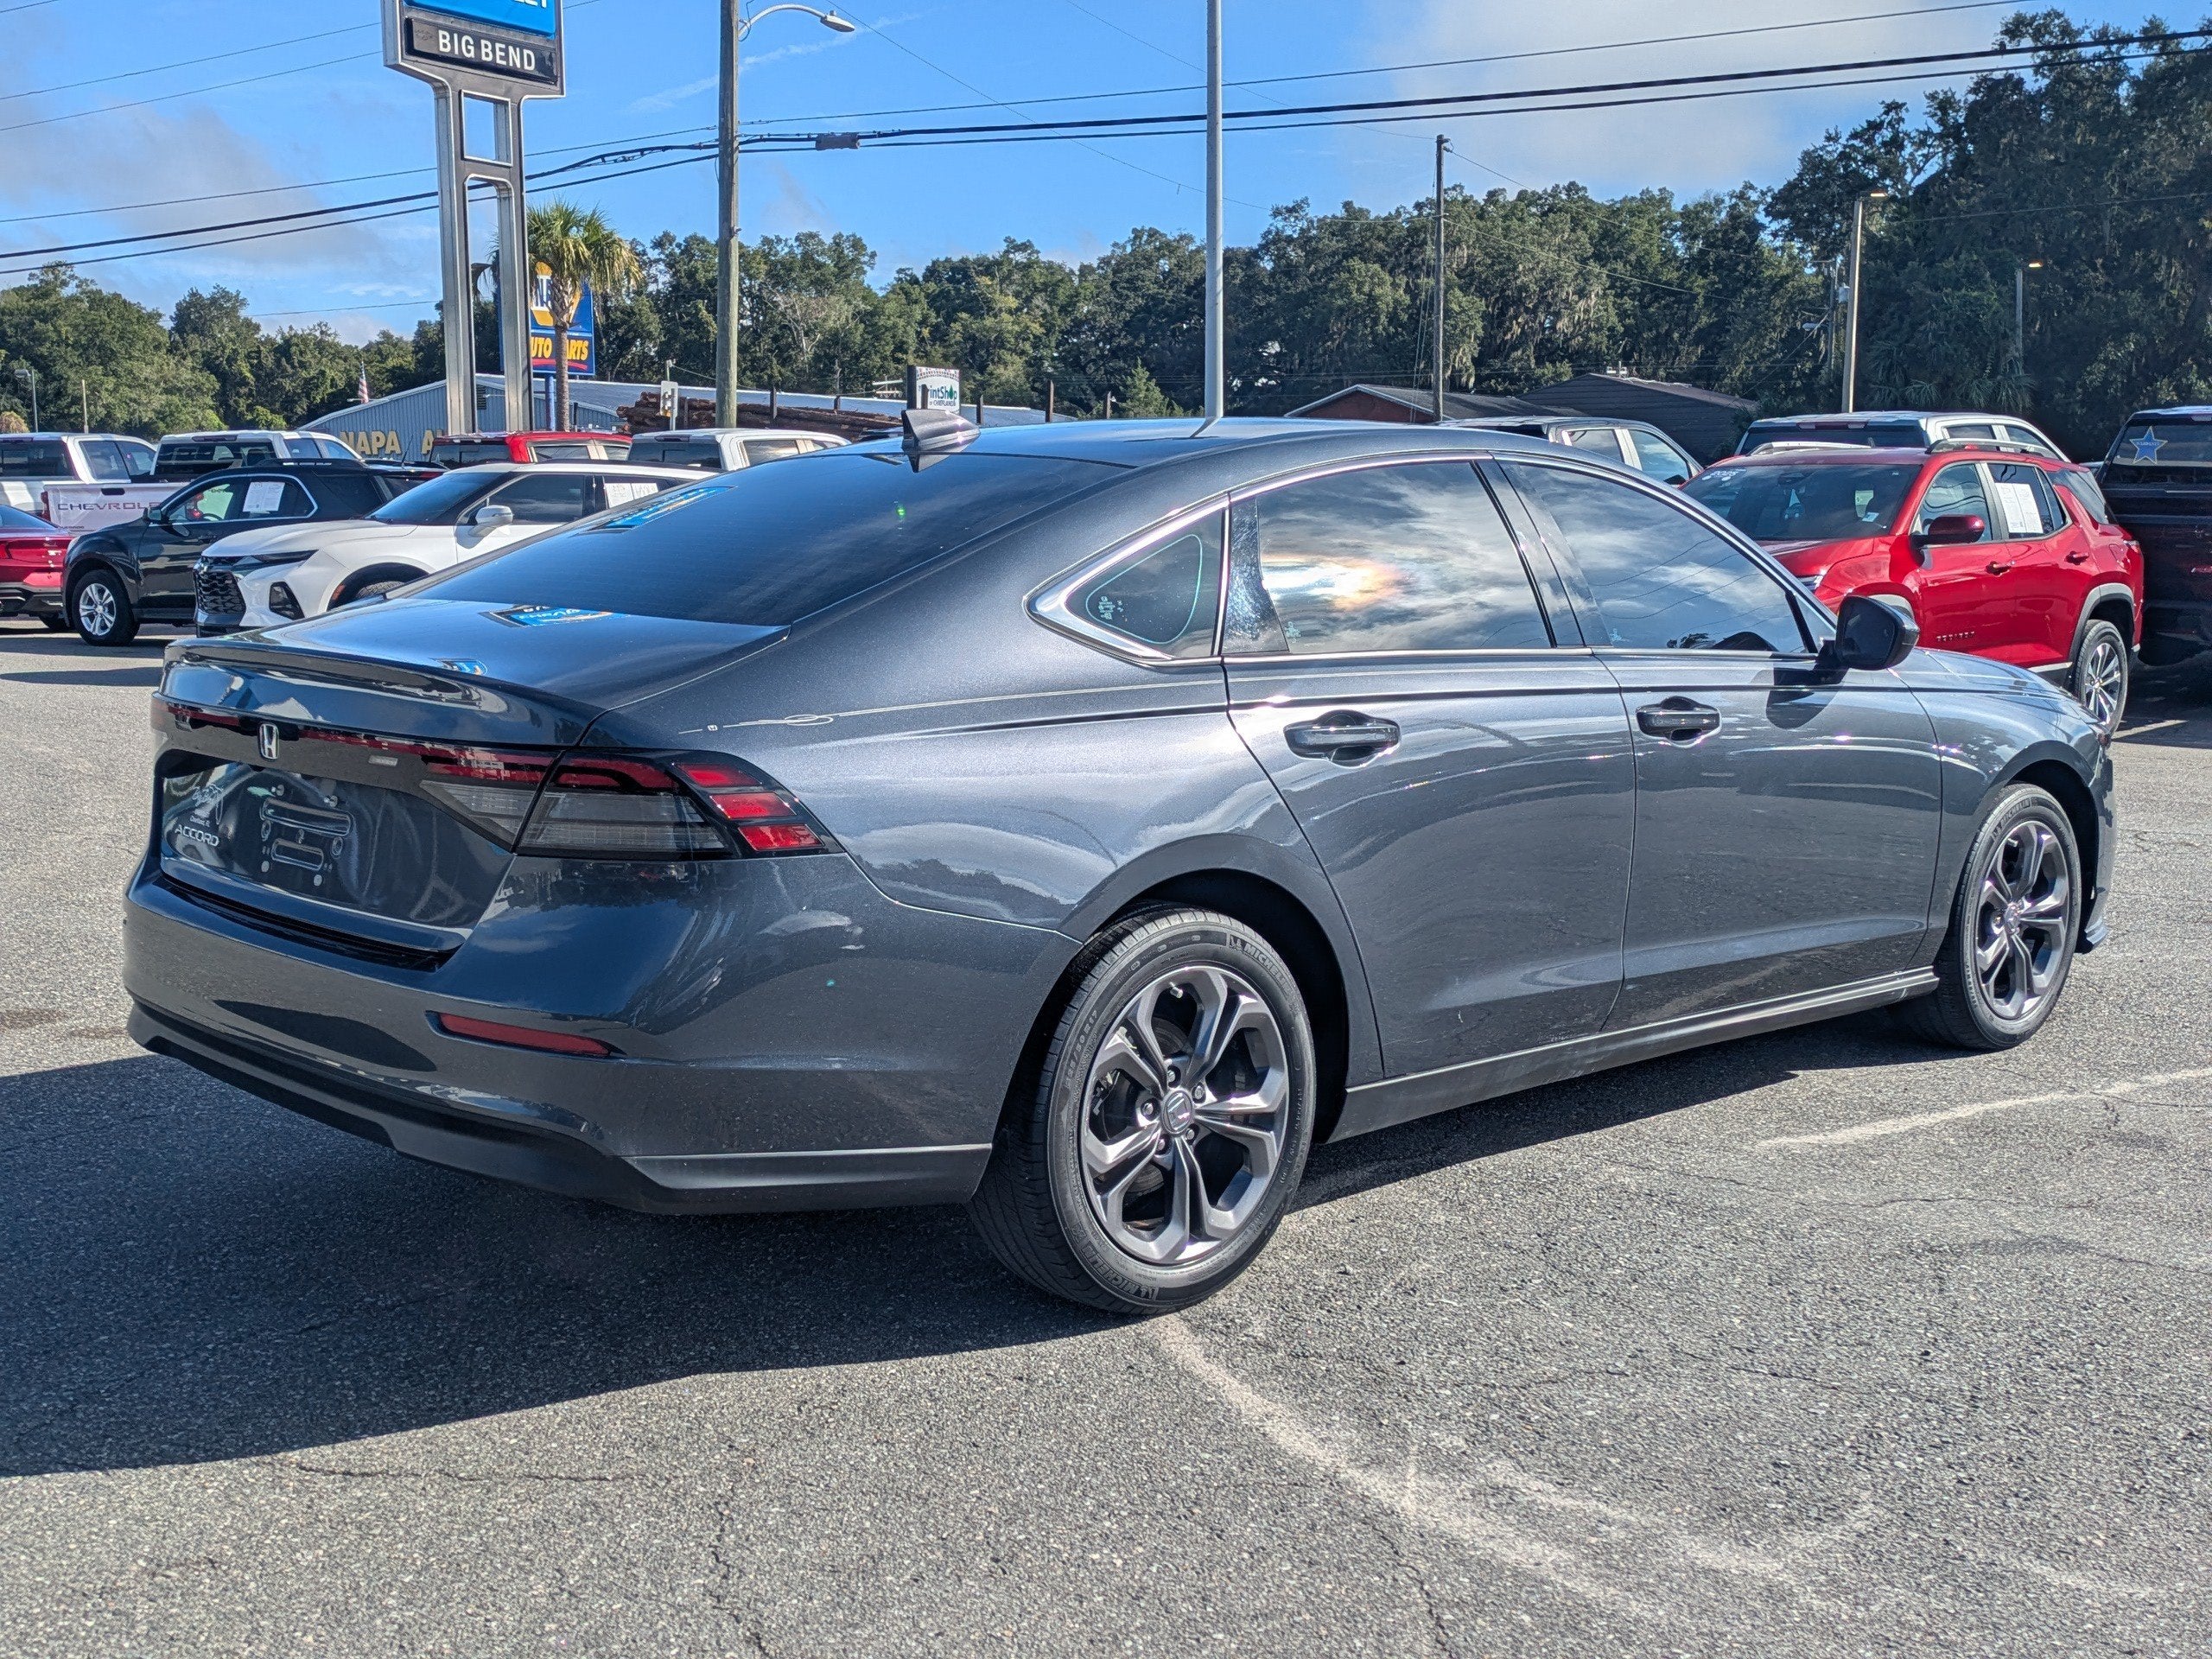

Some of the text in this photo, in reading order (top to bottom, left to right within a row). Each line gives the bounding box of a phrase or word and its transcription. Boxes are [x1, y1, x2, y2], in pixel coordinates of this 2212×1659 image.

[438, 29, 536, 71] BIG BEND
[531, 337, 588, 361] UTO ARTS
[340, 430, 402, 455] NAPA
[57, 502, 162, 511] CHEVROLE
[175, 824, 219, 847] ACCORD
[1081, 1244, 1140, 1296] MICHELIN
